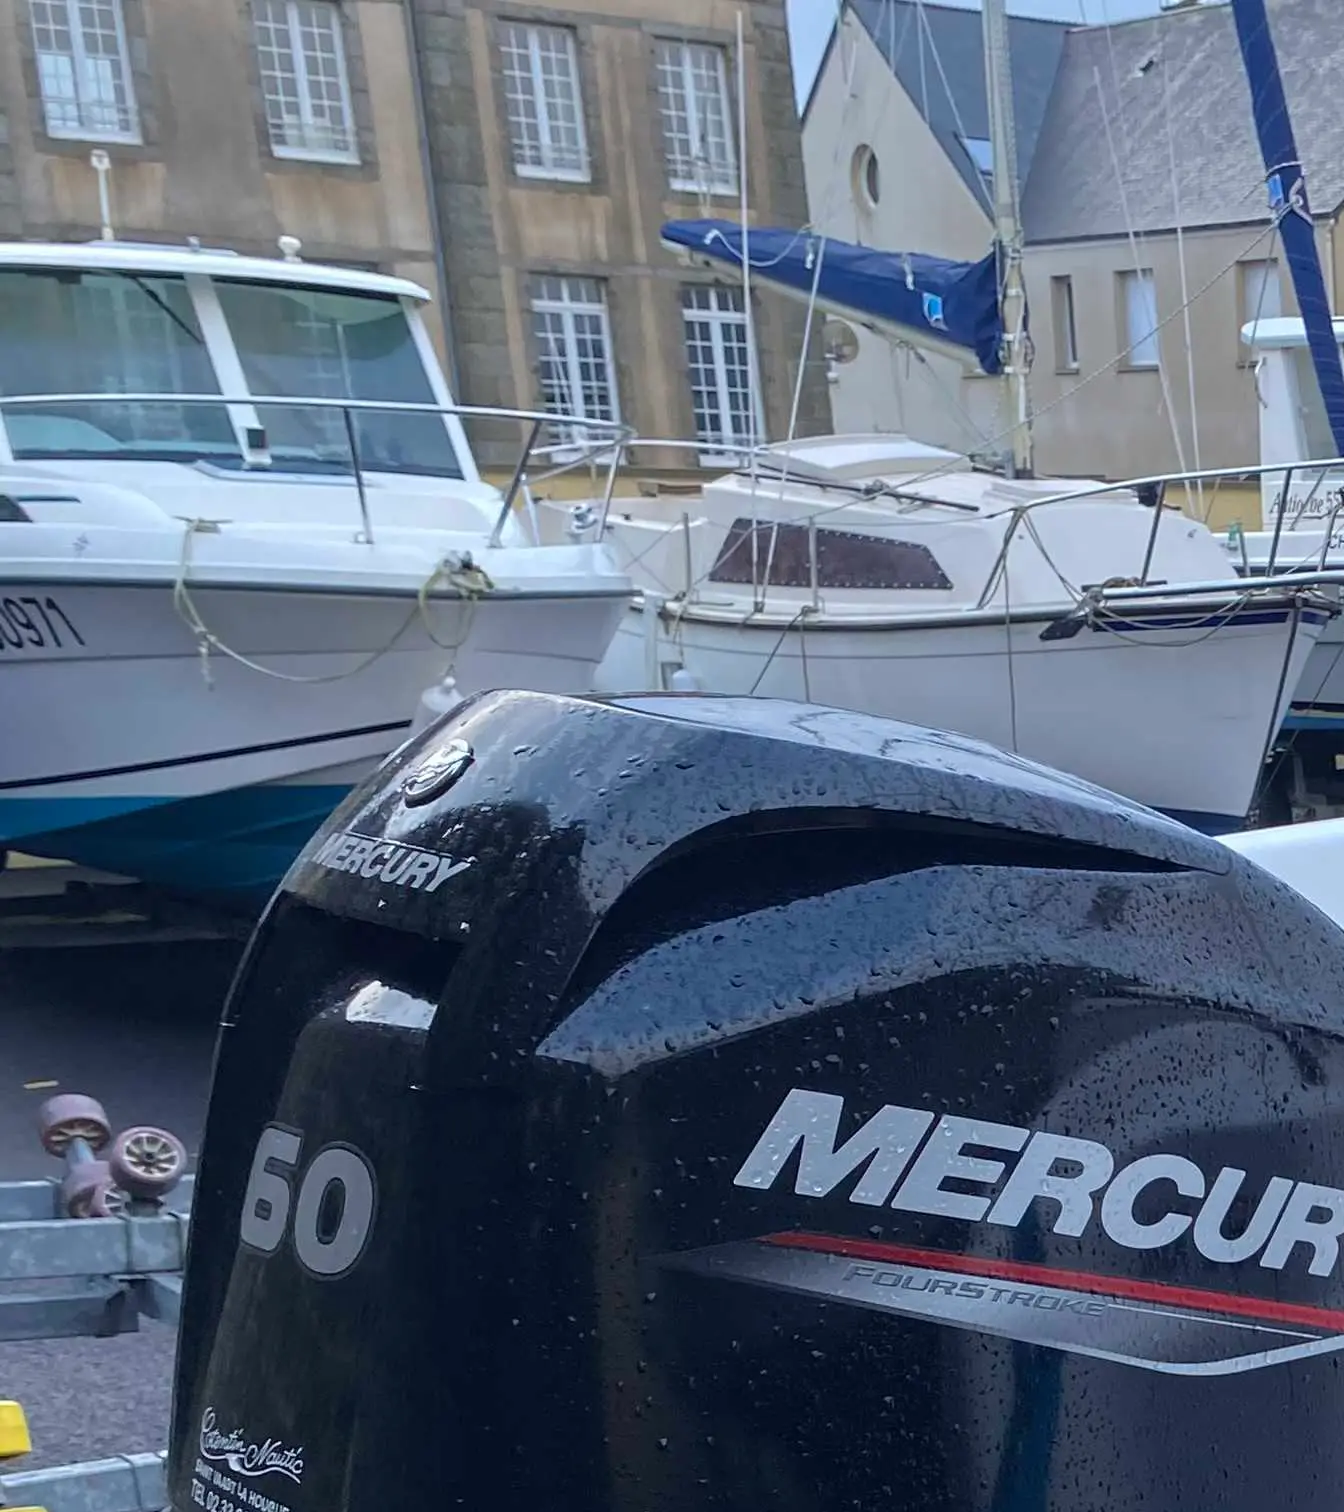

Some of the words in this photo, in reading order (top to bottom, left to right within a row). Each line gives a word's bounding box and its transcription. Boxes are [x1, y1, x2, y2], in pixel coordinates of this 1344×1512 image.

[0, 596, 86, 649] 0971
[311, 833, 478, 893] MERCURY
[240, 1125, 376, 1277] 60
[244, 1438, 305, 1475] Nautic
[237, 1481, 248, 1502] LA
